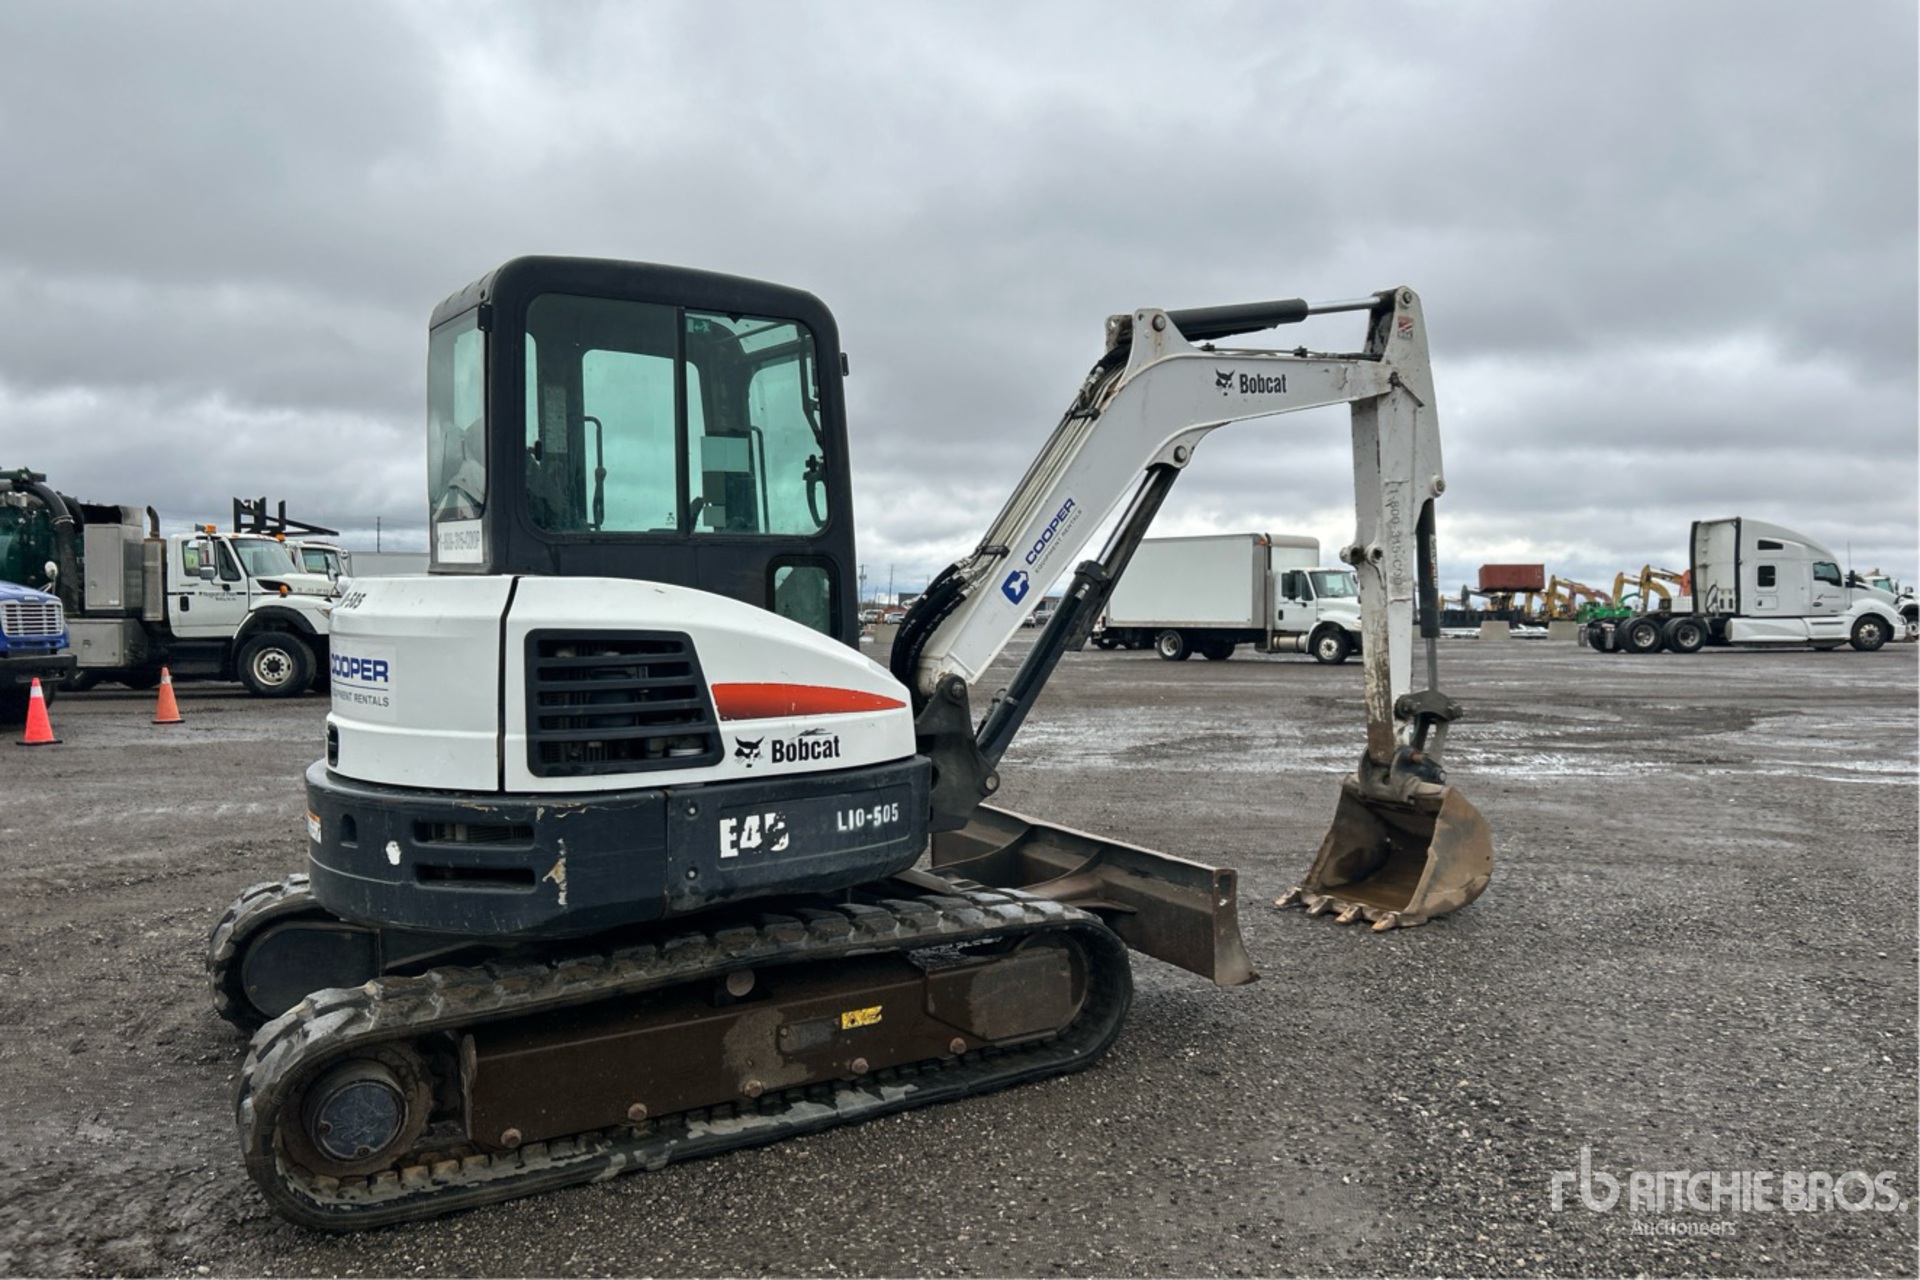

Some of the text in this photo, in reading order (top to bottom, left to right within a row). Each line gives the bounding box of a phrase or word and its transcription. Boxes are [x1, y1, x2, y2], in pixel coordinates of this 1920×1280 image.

[1239, 373, 1287, 394] Bobcat
[1025, 498, 1076, 565] COOPER
[1034, 509, 1083, 574] EQUIPMENT RENTALS
[353, 693, 389, 707] RENTALS
[771, 736, 840, 764] Bobcat
